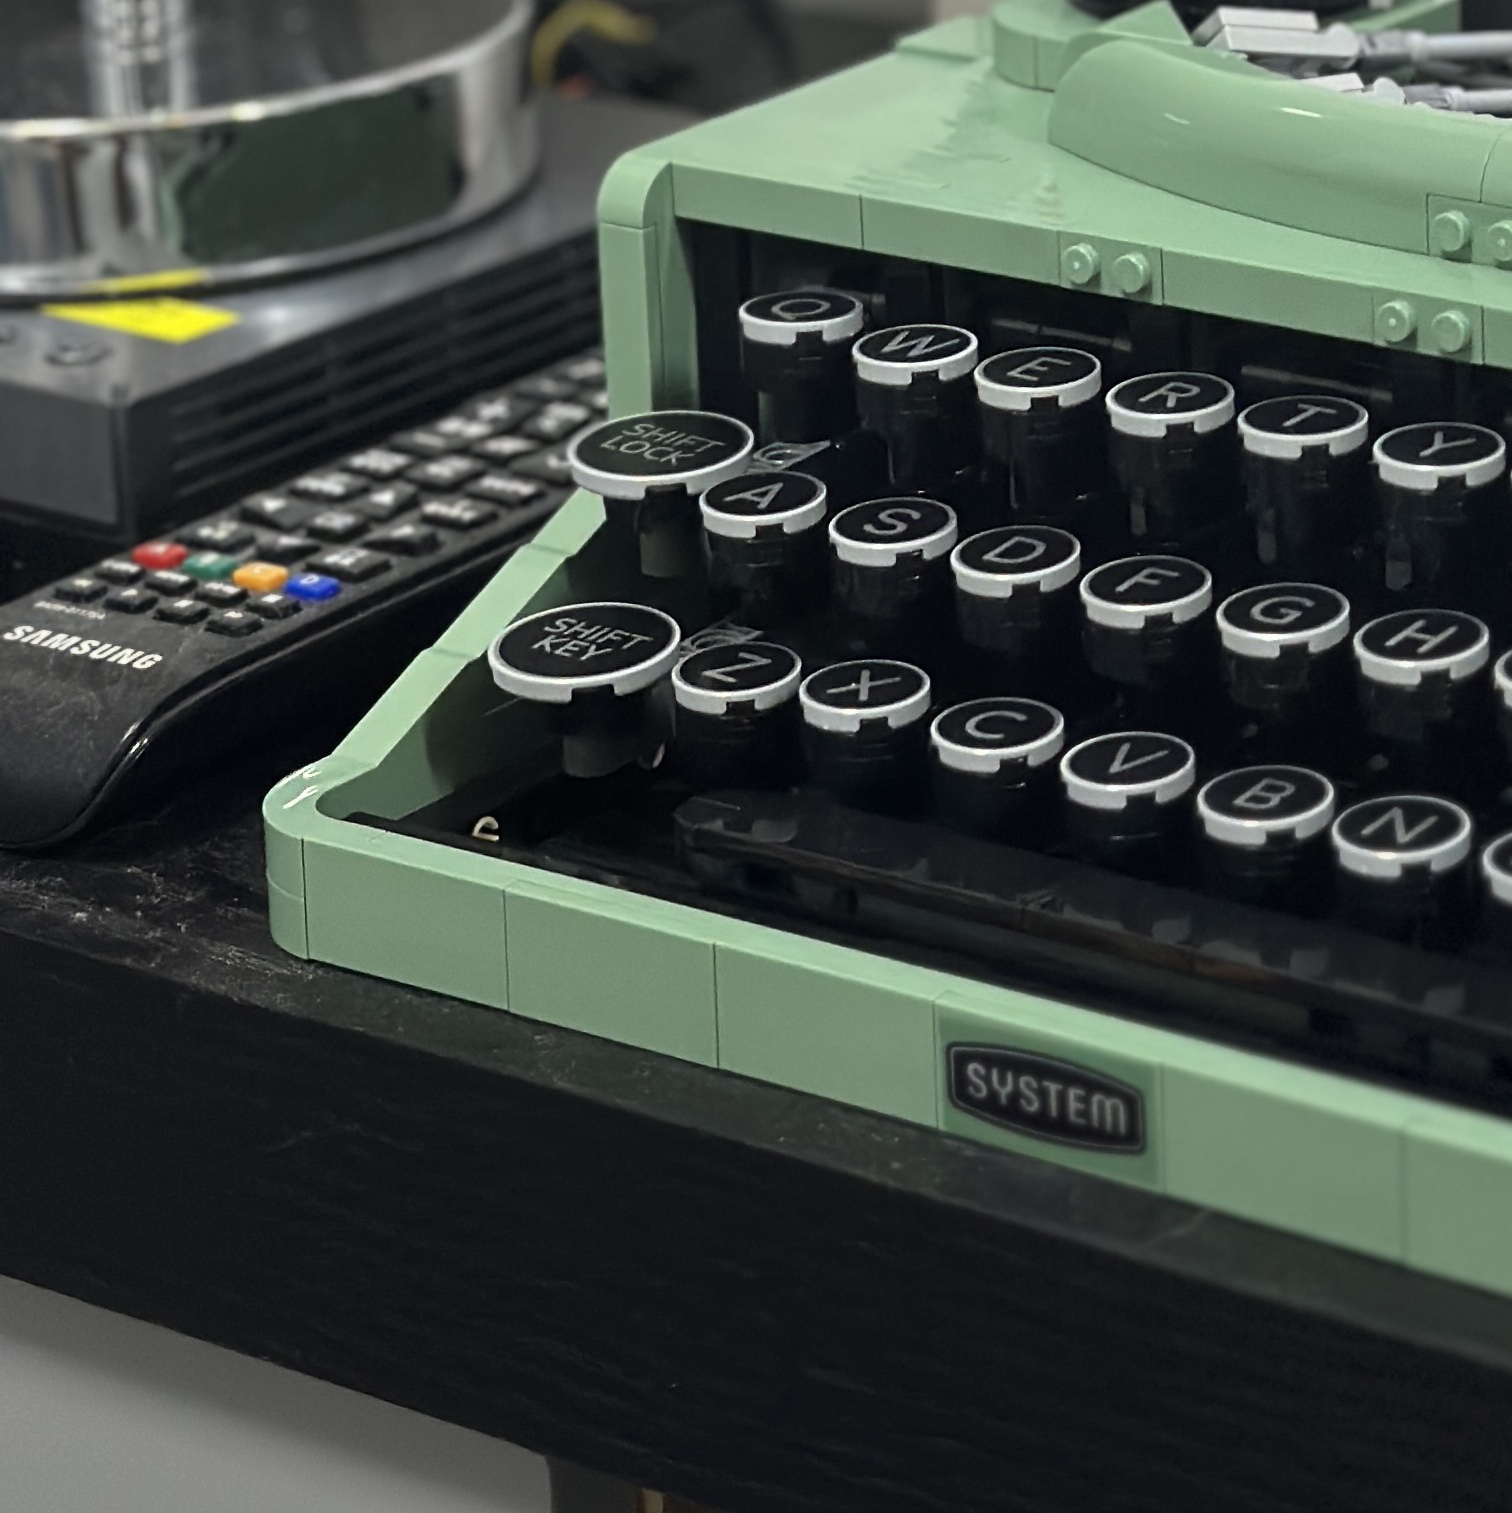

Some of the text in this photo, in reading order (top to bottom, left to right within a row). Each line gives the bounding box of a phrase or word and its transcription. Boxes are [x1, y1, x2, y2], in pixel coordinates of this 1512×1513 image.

[771, 298, 831, 321] Q
[880, 331, 957, 359] W
[1006, 356, 1072, 382] E
[1138, 382, 1200, 408] R
[1282, 403, 1337, 427] T
[600, 435, 695, 466] LOCK
[622, 424, 727, 453] SHIFT
[1419, 431, 1476, 457] Y
[723, 482, 784, 510] A
[863, 508, 922, 536] S
[982, 536, 1046, 564] D
[1115, 567, 1180, 593] F
[1250, 596, 1315, 625] G
[3, 624, 163, 670] SAMSUNG
[531, 634, 613, 661] KEY
[544, 617, 655, 650] SHIFT
[1384, 619, 1458, 654] H
[701, 652, 772, 683] Z
[826, 669, 901, 702] X
[965, 710, 1028, 740] C
[1108, 742, 1169, 774] V
[1232, 778, 1296, 810] B
[1360, 807, 1438, 845] N
[966, 1061, 1127, 1136] SYSTEM
